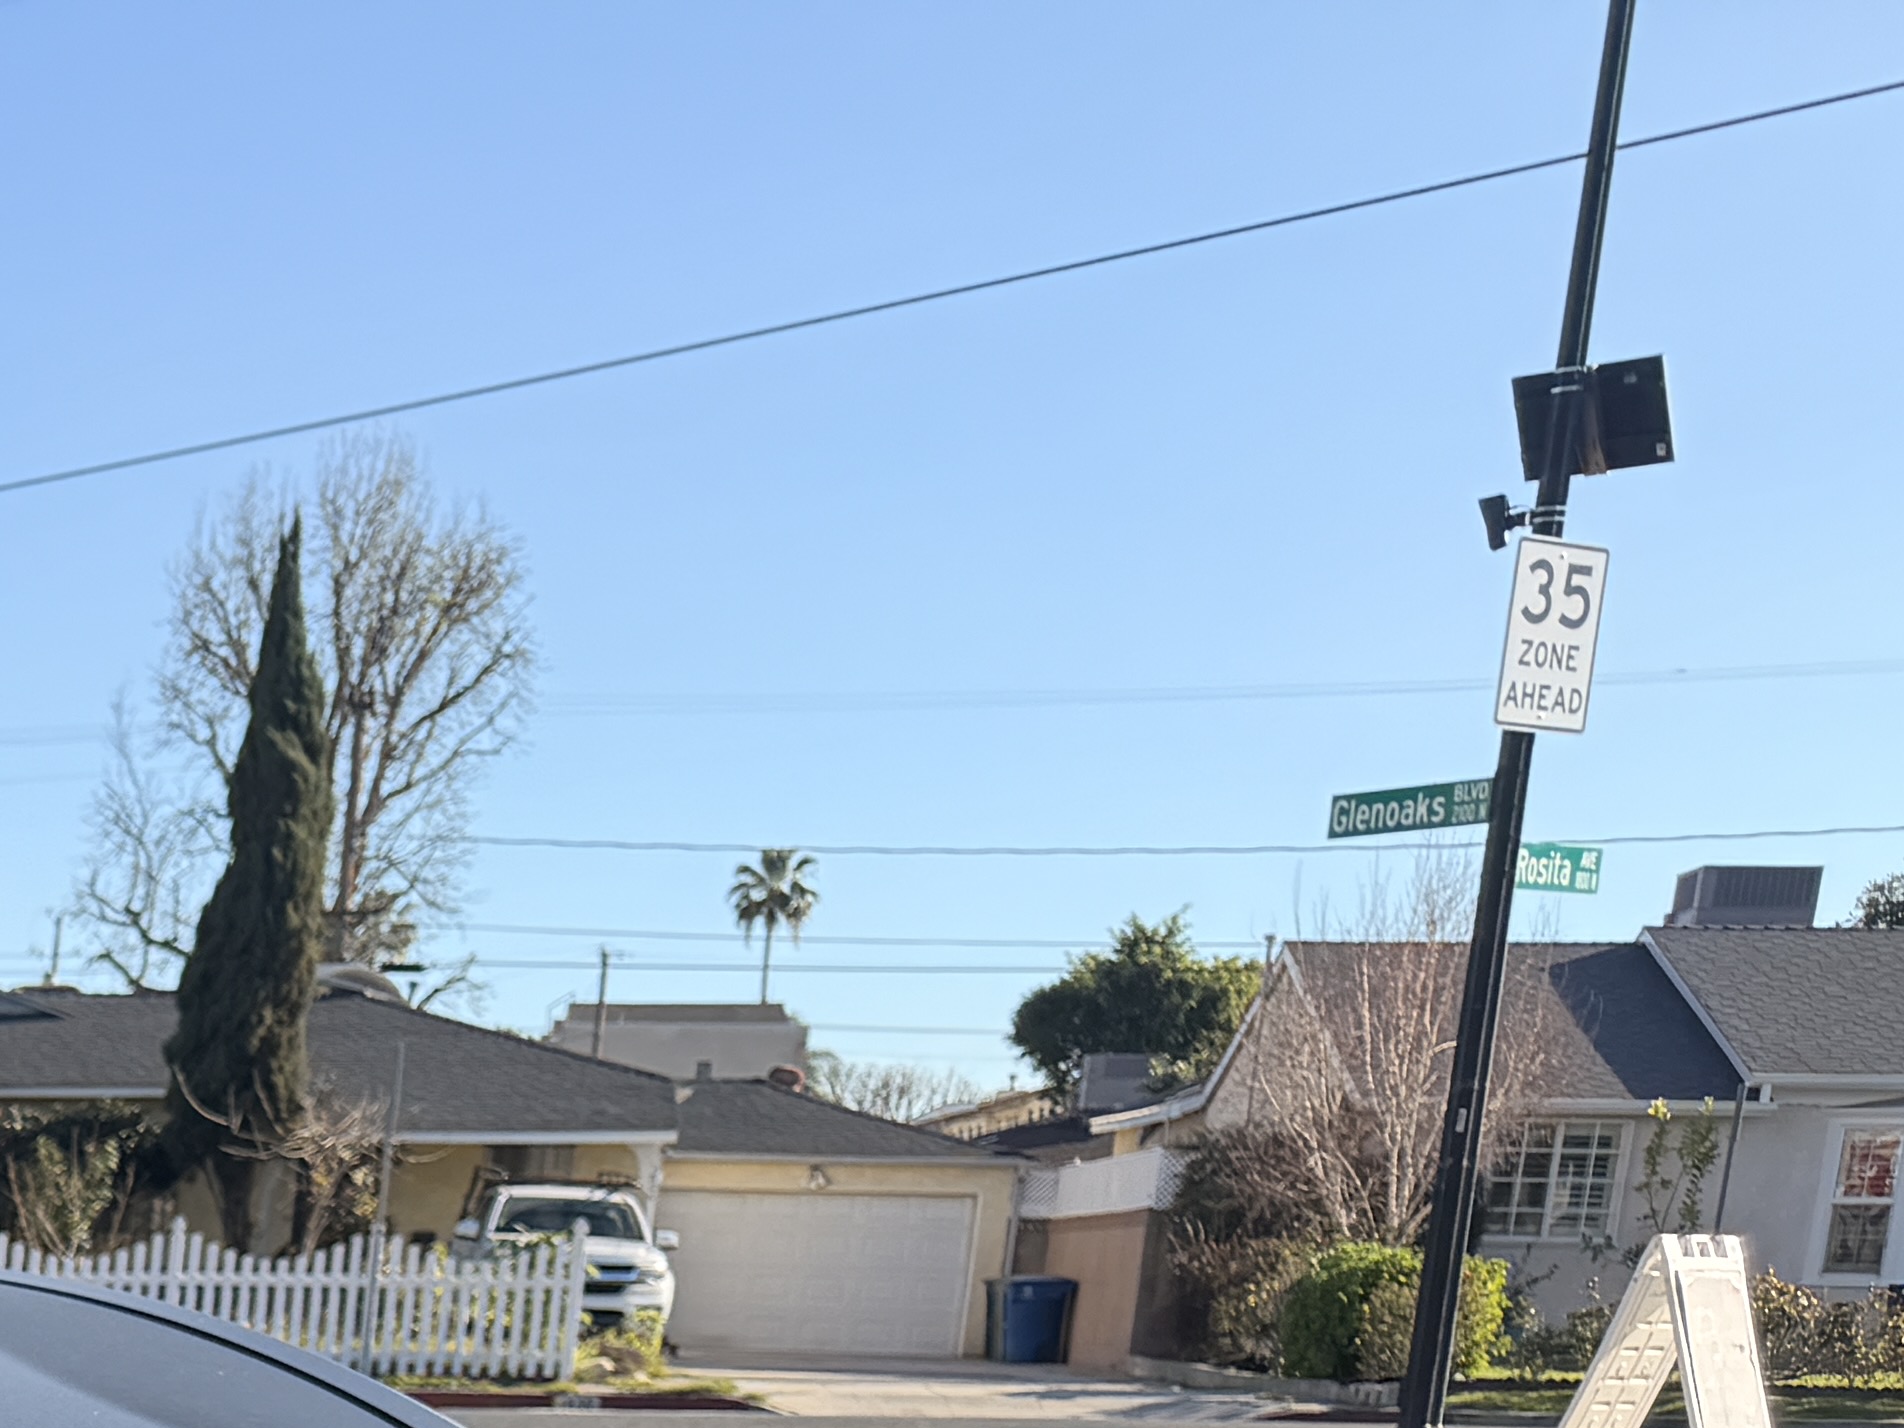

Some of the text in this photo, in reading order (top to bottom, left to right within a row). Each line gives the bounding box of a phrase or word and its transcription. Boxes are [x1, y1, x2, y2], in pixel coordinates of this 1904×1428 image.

[1521, 558, 1593, 630] 35
[1518, 638, 1581, 673] ZONE
[1502, 680, 1584, 715] AHEAD
[1453, 781, 1490, 803] BLVD
[1332, 791, 1447, 834] Glenoaks
[1515, 847, 1572, 887] Rosita
